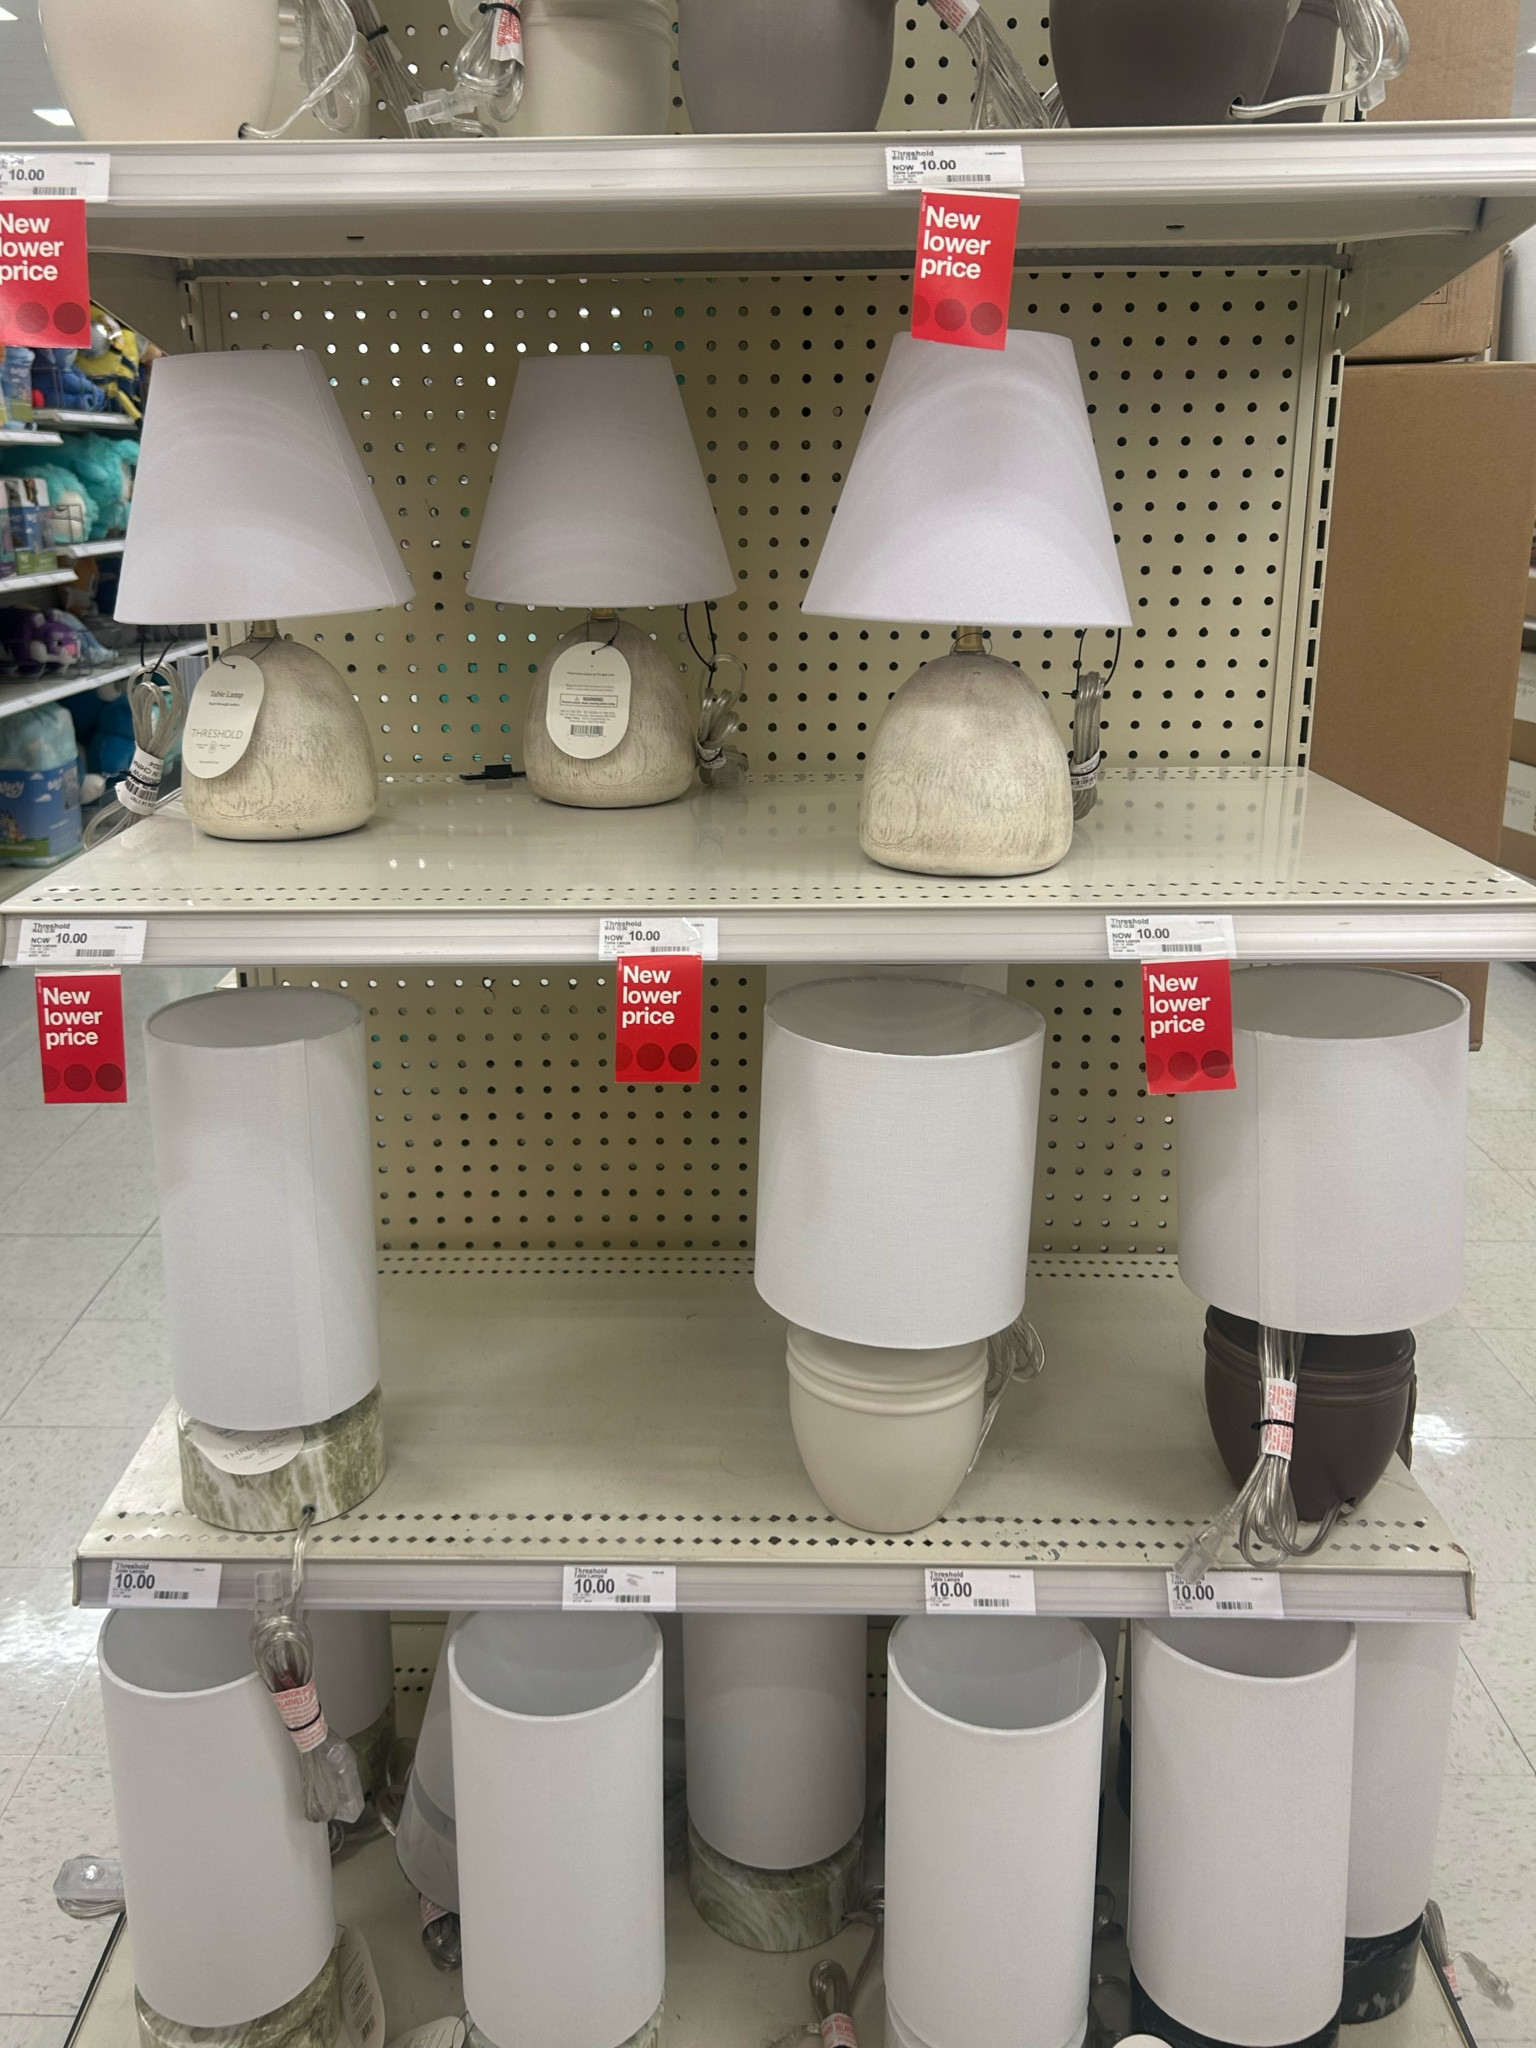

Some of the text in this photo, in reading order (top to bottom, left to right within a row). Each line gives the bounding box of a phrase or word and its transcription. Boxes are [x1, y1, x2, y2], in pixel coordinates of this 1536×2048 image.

[920, 160, 957, 170] 10.00
[8, 169, 45, 181] 10.00
[0, 213, 51, 234] New
[925, 205, 981, 231] New
[923, 229, 991, 255] lower
[0, 260, 59, 285] price
[920, 255, 981, 279] price
[210, 690, 244, 700] Table Lamp
[192, 728, 243, 740] THRESHOLD
[56, 933, 88, 944] 10.00
[629, 930, 660, 941] 10.00
[1137, 928, 1170, 939] 10.00
[623, 965, 671, 984] New
[1148, 974, 1199, 993] New
[42, 987, 91, 1006] New
[623, 986, 682, 1004] lower
[1149, 995, 1211, 1014] lower
[44, 1007, 103, 1026] lower
[622, 1006, 675, 1029] price
[1150, 1014, 1205, 1039] price
[45, 1027, 99, 1050] price
[223, 1429, 290, 1460] THRESHOLD
[115, 1562, 150, 1570] Threshold
[115, 1573, 155, 1589] 10.00
[574, 1578, 615, 1594] 10.00
[931, 1582, 972, 1597] 10.00
[1173, 1585, 1215, 1600] 10.00
